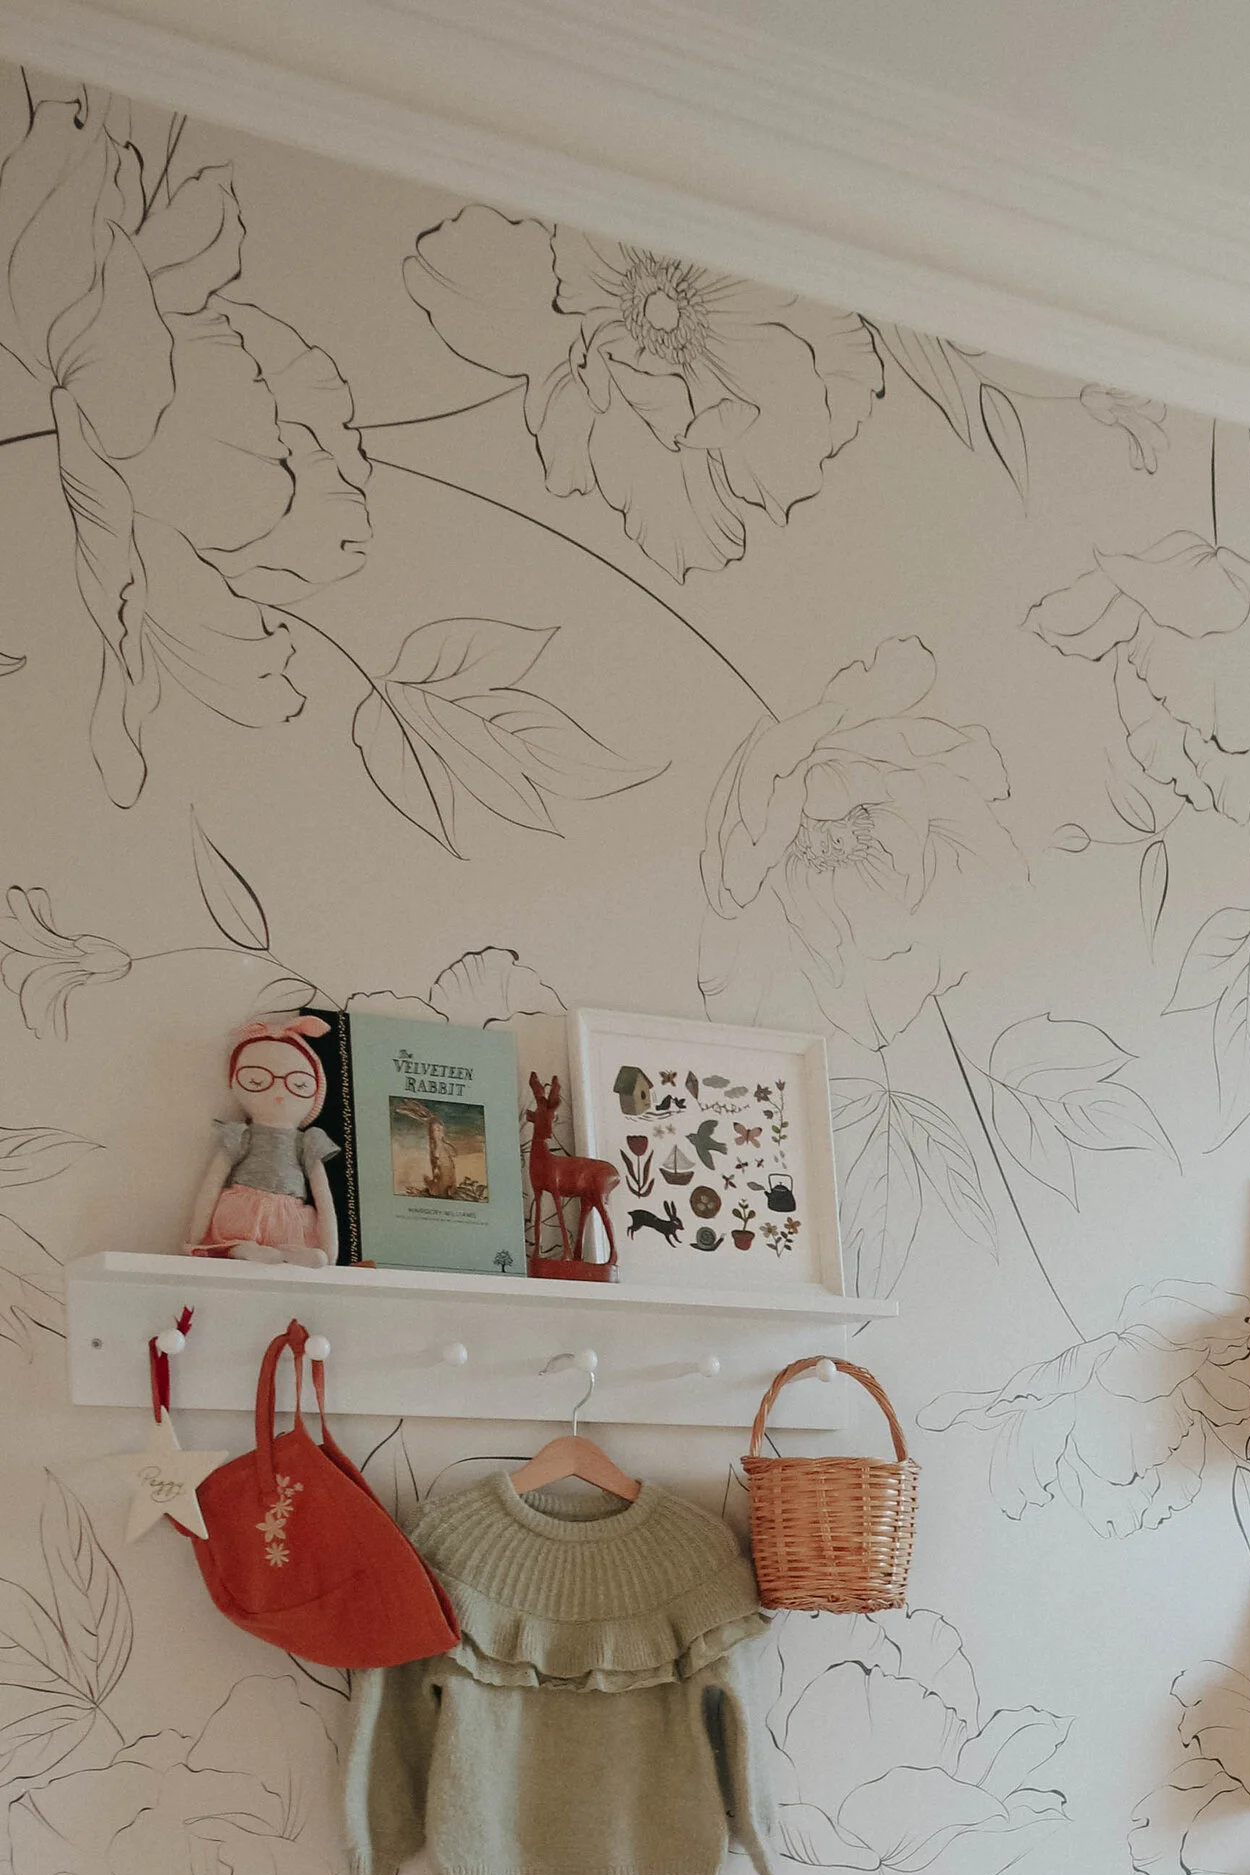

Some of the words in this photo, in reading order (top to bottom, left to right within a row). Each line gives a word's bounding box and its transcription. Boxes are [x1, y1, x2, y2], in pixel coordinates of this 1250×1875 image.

[392, 1058, 474, 1081] VELVETEEN
[404, 1076, 466, 1097] RABBIT
[137, 1465, 185, 1504] Peggy
